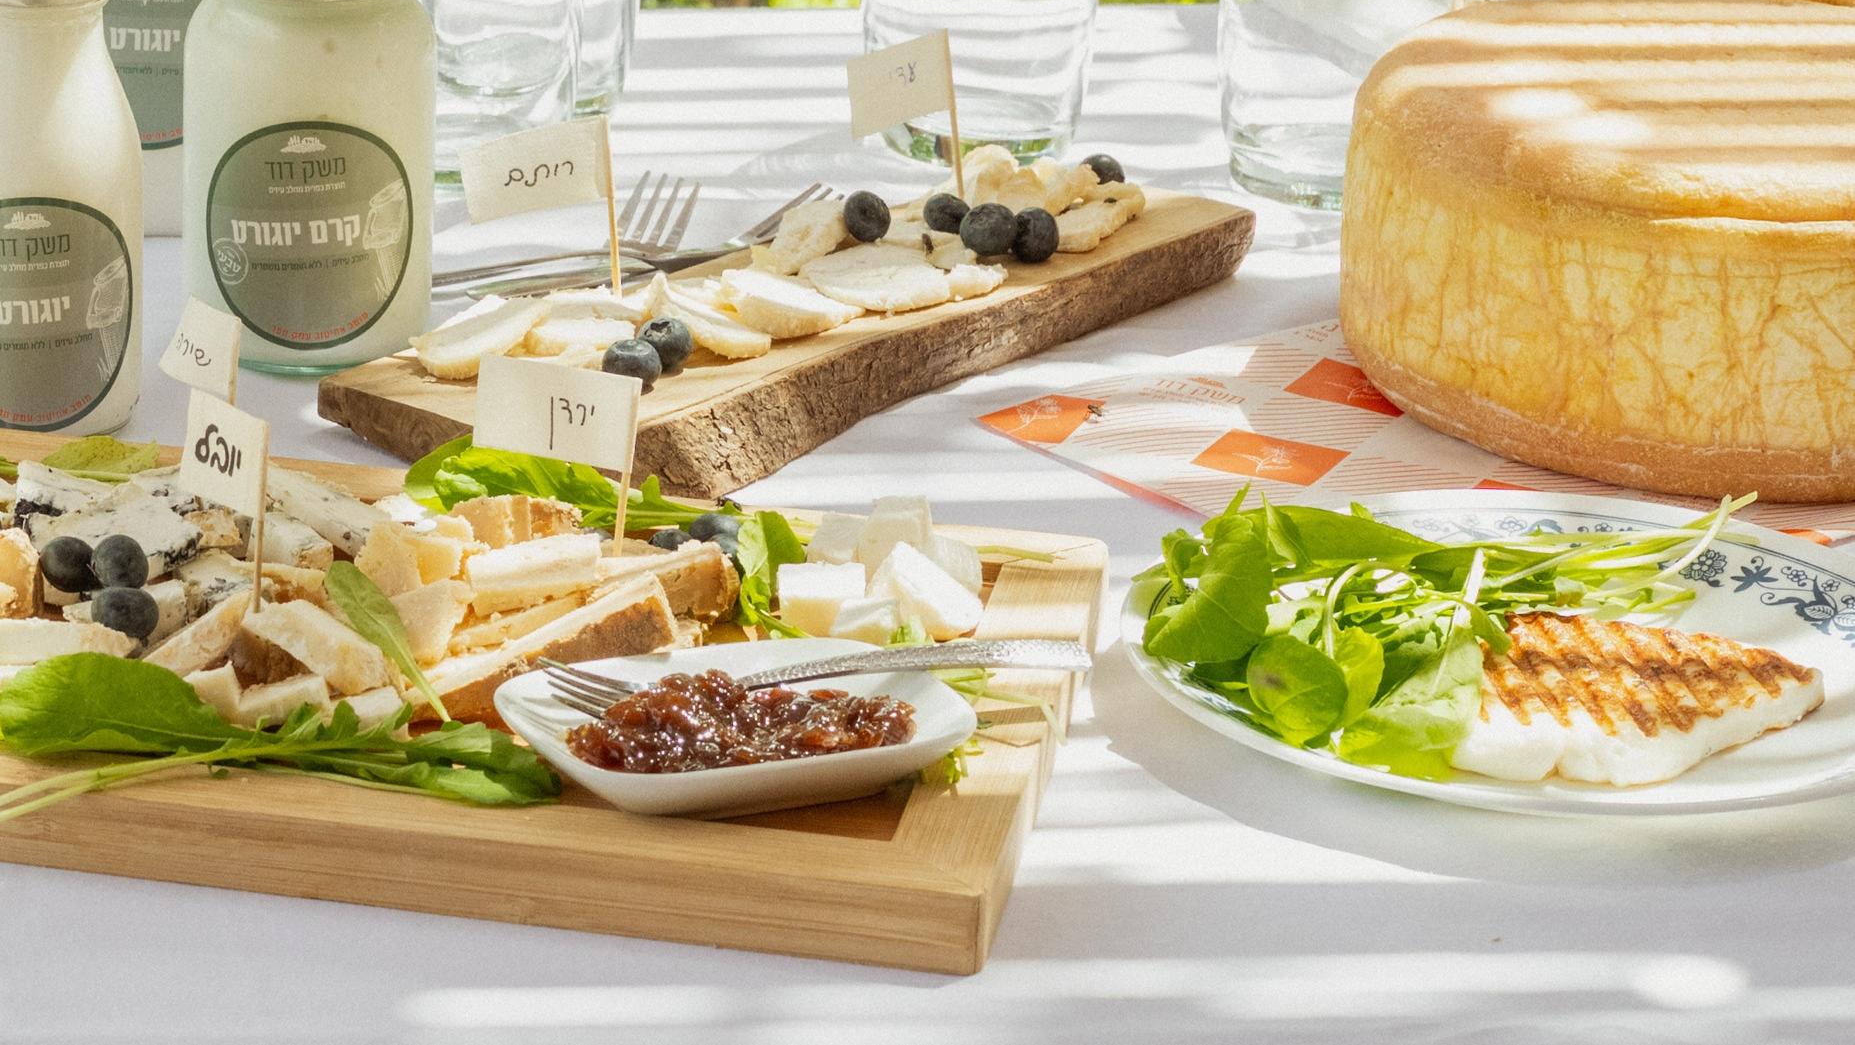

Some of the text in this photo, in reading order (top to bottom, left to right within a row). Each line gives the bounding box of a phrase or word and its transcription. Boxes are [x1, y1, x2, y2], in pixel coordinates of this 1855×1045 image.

[109, 26, 181, 52] יוגורט
[265, 157, 346, 184] משק דוד
[504, 160, 574, 187] רותם
[231, 214, 361, 246] קרם יוגורט
[24, 234, 71, 262] משק
[549, 396, 595, 451] ירדן
[194, 423, 242, 477] יובל
